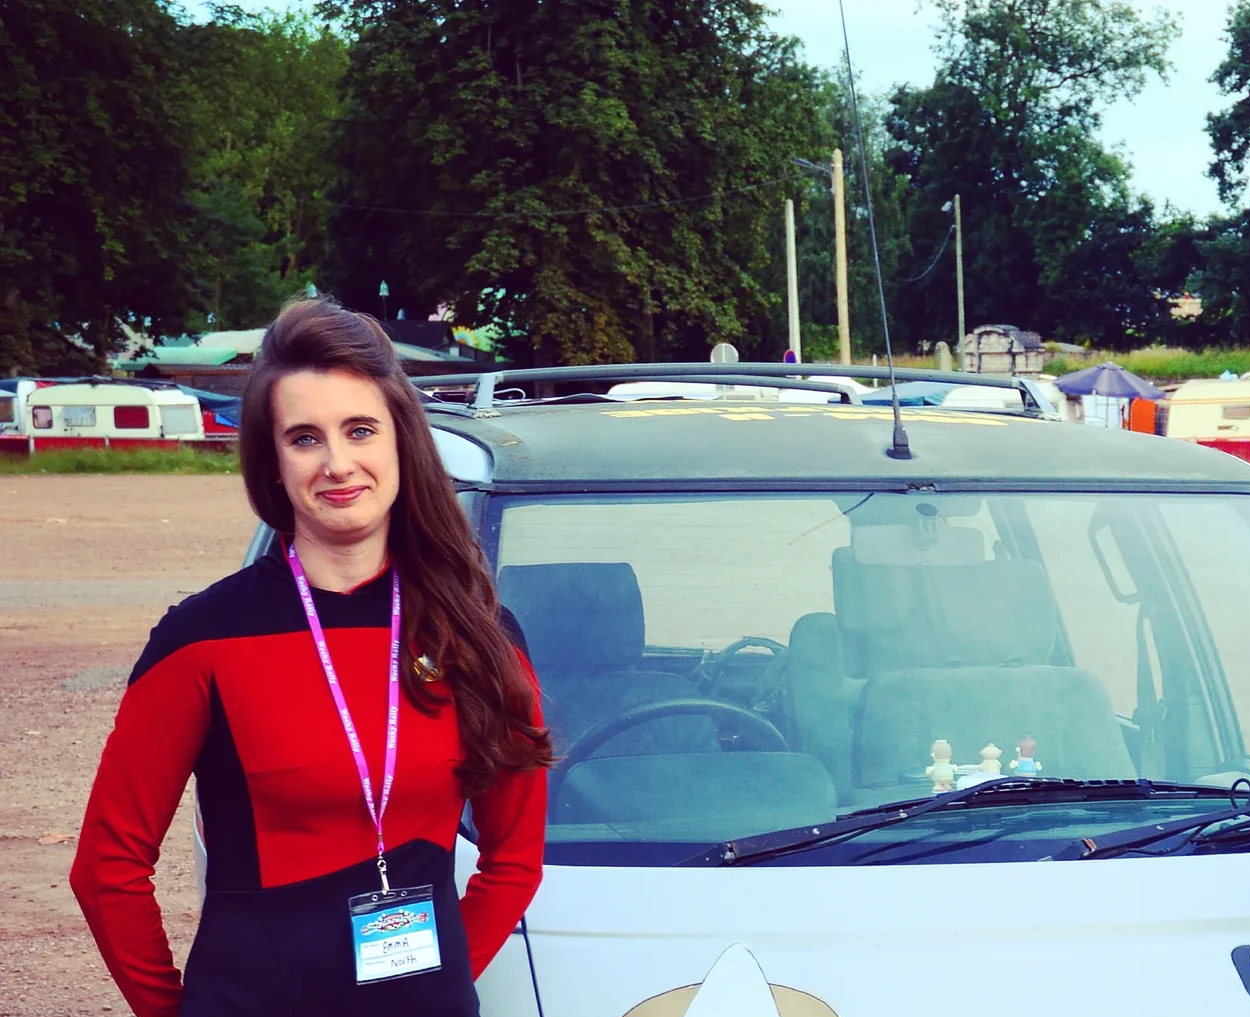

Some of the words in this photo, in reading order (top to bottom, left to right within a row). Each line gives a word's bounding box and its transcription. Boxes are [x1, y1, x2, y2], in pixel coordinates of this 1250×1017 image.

[317, 640, 331, 665] Wacky
[325, 664, 338, 685] Rally
[341, 708, 354, 732] Wacky
[349, 732, 361, 753] Rally
[388, 704, 399, 725] Rally
[387, 726, 398, 750] Wacky
